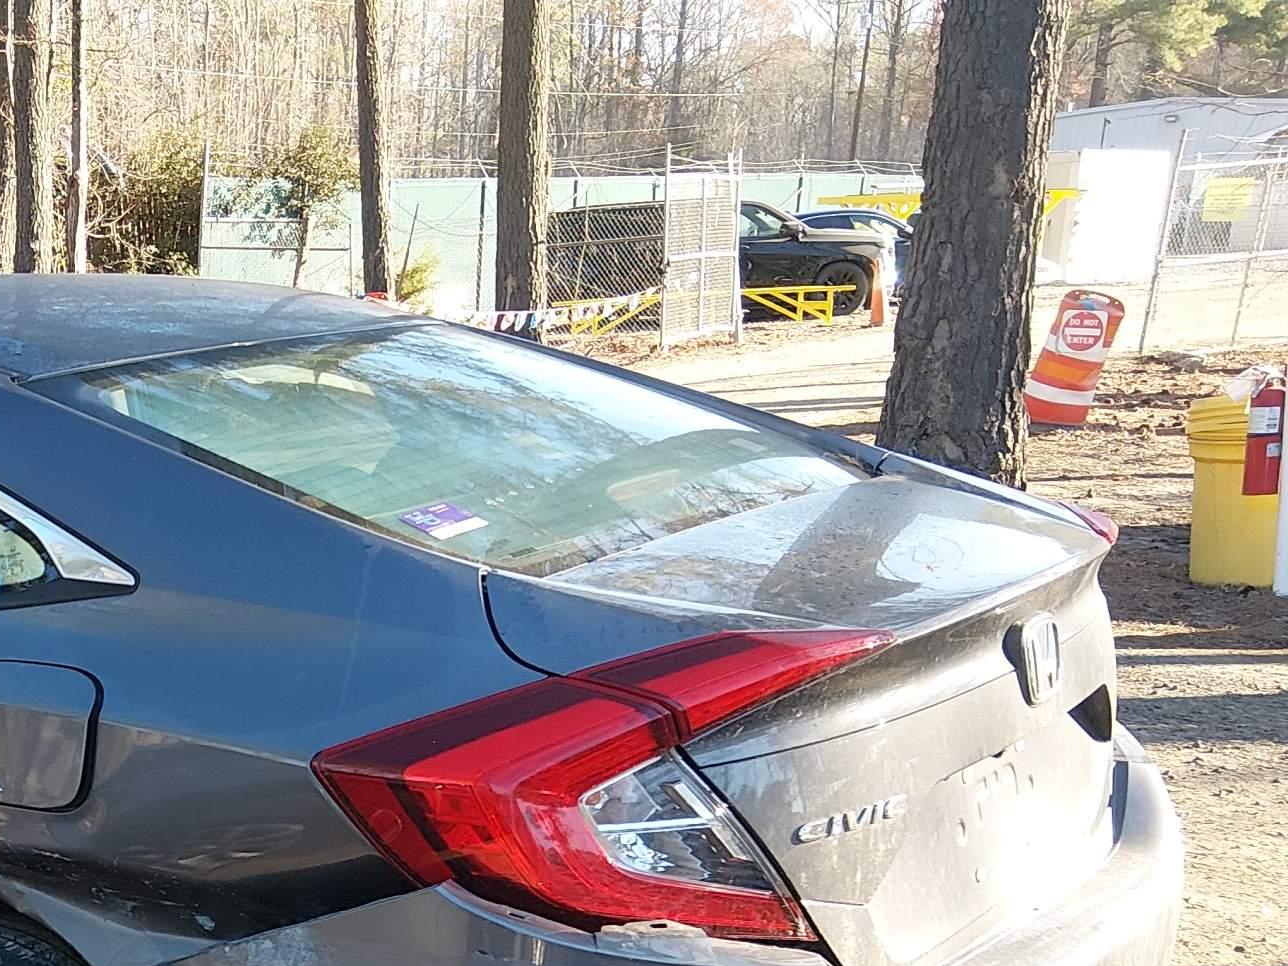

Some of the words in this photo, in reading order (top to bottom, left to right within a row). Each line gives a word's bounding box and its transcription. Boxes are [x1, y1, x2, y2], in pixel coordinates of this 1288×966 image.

[1069, 318, 1081, 326] DO
[1083, 319, 1099, 327] NOT
[1067, 336, 1095, 345] ENTER
[795, 793, 908, 843] CIVIC
